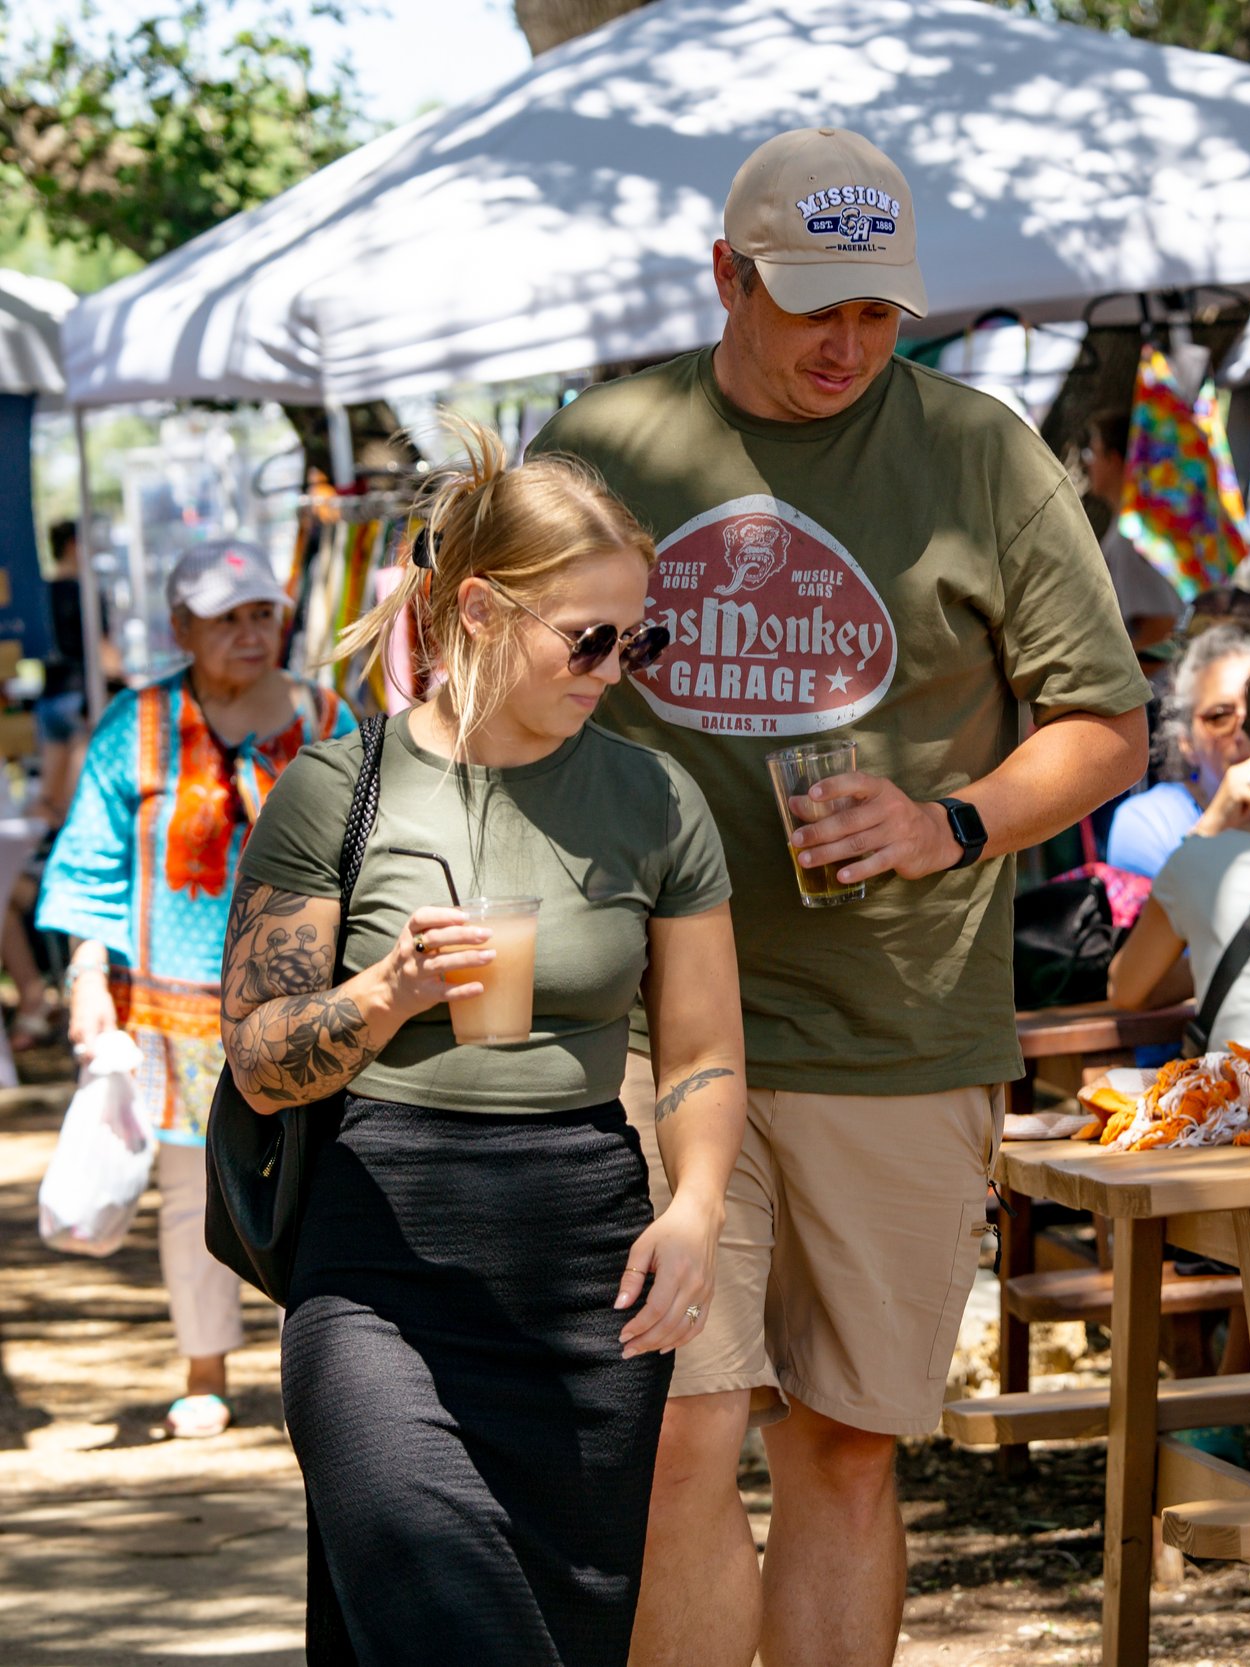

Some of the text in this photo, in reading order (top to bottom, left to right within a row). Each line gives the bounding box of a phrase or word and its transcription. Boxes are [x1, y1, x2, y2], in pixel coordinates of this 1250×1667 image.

[796, 185, 901, 219] MISSIONS
[813, 220, 893, 231] EST. 1888
[837, 244, 877, 252] BASEBALL
[659, 561, 707, 575] STREET
[662, 575, 698, 589] RODS
[791, 569, 843, 586] MUSCLE
[798, 583, 833, 598] CARS
[670, 660, 816, 703] GARAGE
[702, 715, 777, 732] DALLAS, TX
